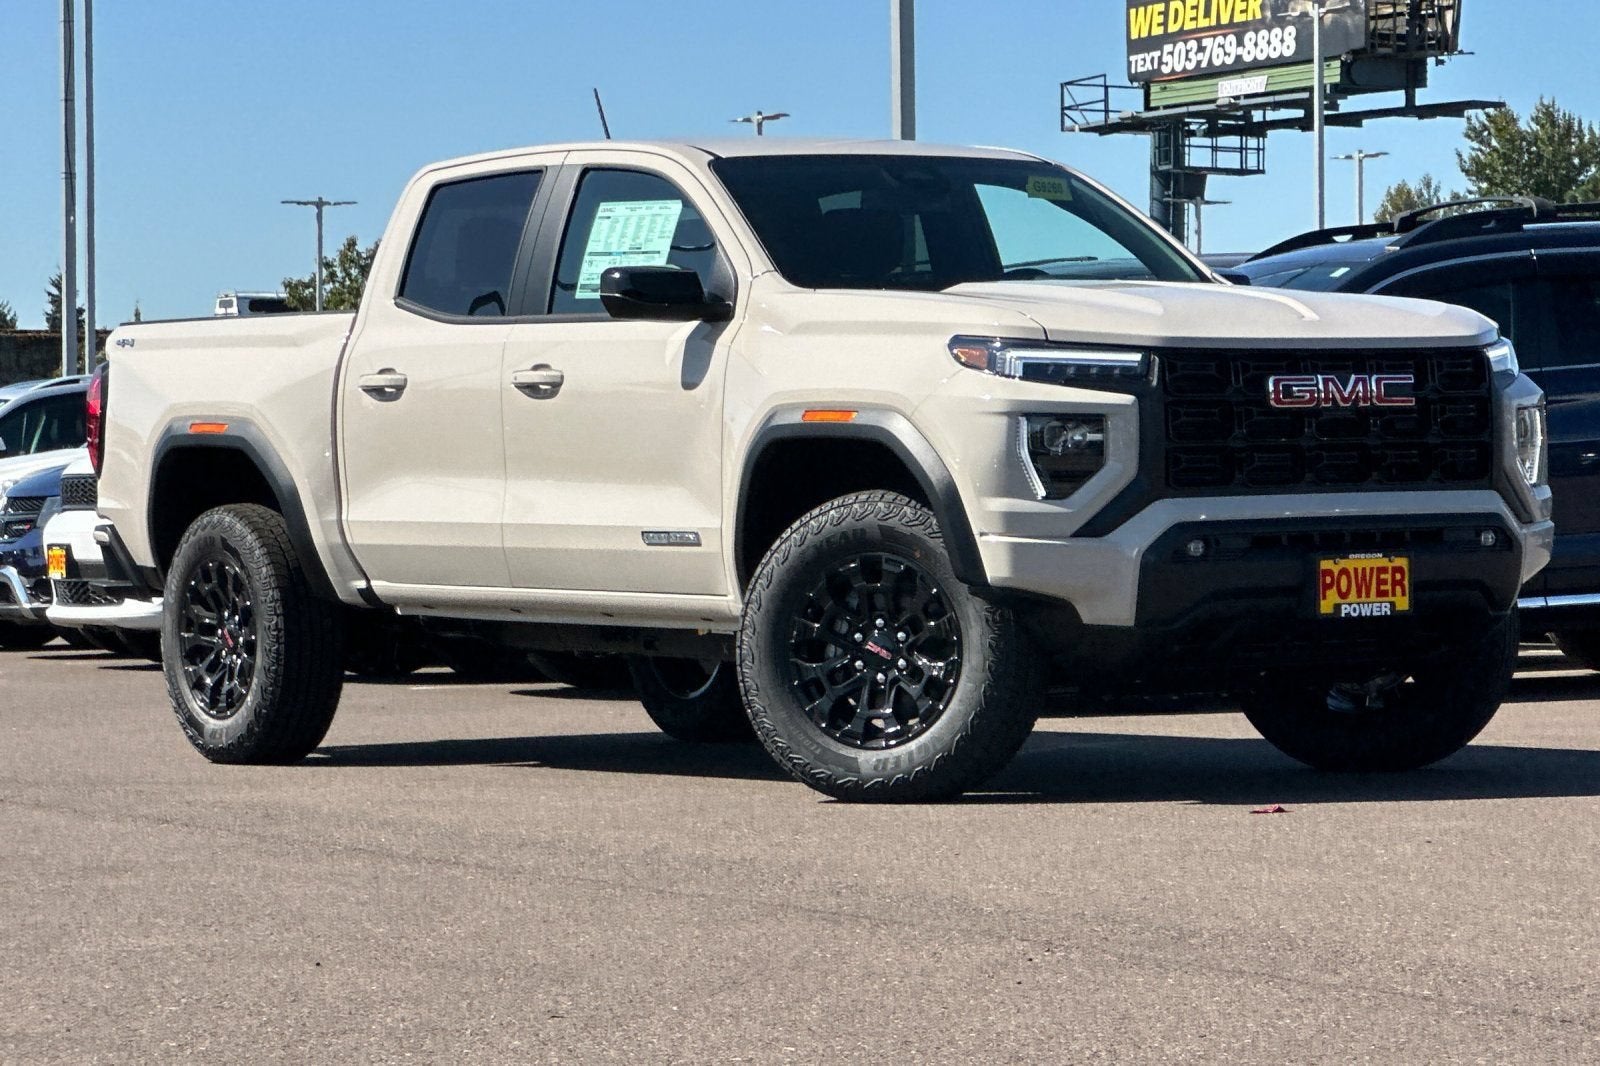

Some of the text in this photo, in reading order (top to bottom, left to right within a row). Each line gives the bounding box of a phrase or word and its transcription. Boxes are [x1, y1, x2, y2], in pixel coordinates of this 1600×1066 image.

[1129, 0, 1263, 40] WE DELIVER
[1129, 25, 1297, 74] TEXT 503-769-8888
[1269, 374, 1415, 408] GMC
[1320, 565, 1407, 601] POWER
[1341, 602, 1391, 617] POWER
